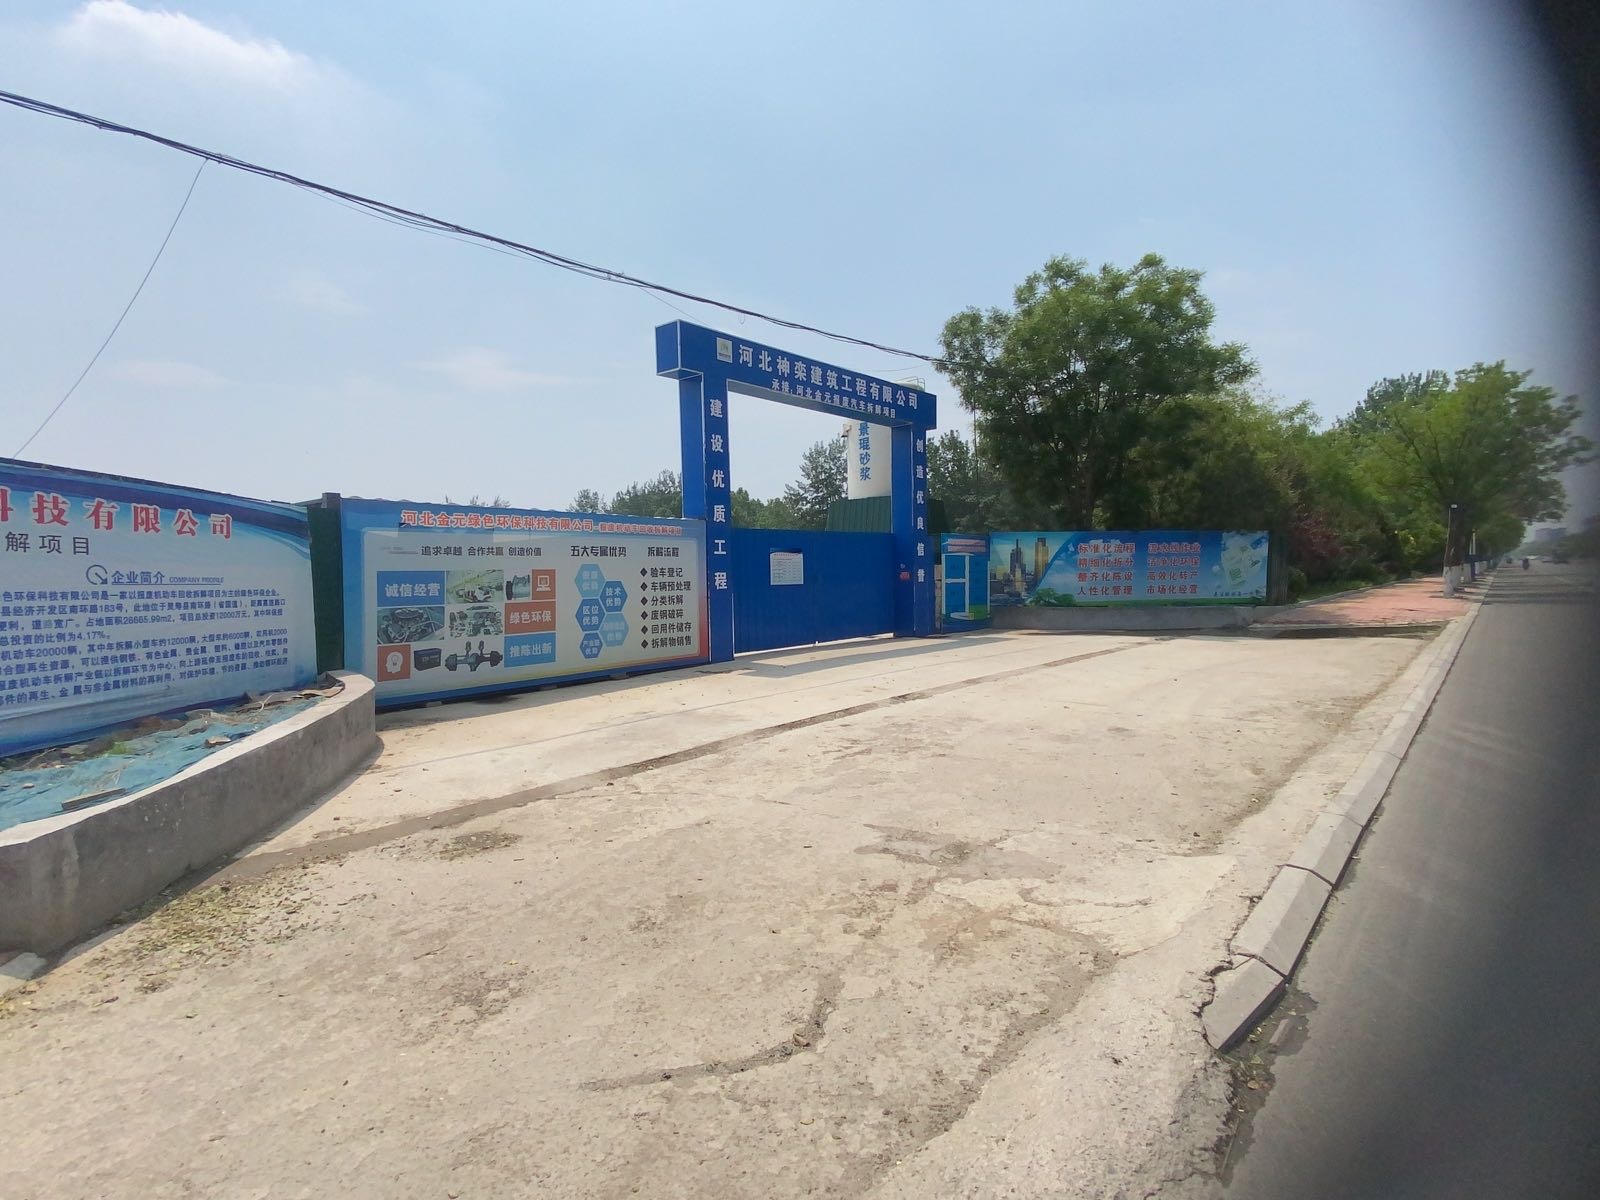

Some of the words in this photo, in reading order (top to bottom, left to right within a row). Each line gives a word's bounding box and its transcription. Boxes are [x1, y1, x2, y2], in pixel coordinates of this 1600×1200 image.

[739, 344, 918, 410] 河北神栾建筑工程有限公司
[709, 398, 728, 592] 建设优质工程
[5, 530, 91, 556] 解项目
[1079, 543, 1135, 553] 标准化流程
[421, 545, 462, 556] 追求卓越
[467, 546, 504, 556] 合作共赢
[508, 546, 542, 557] 创造价值
[571, 545, 627, 558] 五大专属优势
[647, 546, 680, 558] 拆解流程
[1078, 557, 1134, 567] 精细化拆分
[111, 569, 165, 584] 企业简介
[650, 567, 683, 578] 验车登记
[1077, 571, 1133, 582] 整齐化陈设
[168, 576, 200, 584] COMPANY
[384, 582, 441, 599] 诚信经营
[605, 587, 622, 596] 技术
[650, 581, 692, 592] 车辆预处理
[1077, 585, 1133, 596] 人性化管理
[1146, 585, 1199, 595] 市场化经营
[650, 595, 684, 606] 分类拆解
[582, 605, 599, 615] 区位
[650, 609, 684, 620] 废钢破碎
[509, 610, 552, 625] 绿色环保
[582, 616, 599, 625] 优势
[651, 622, 692, 634] 回用件储存
[651, 636, 692, 649] 拆解物销售
[509, 641, 552, 658] 推陈出新
